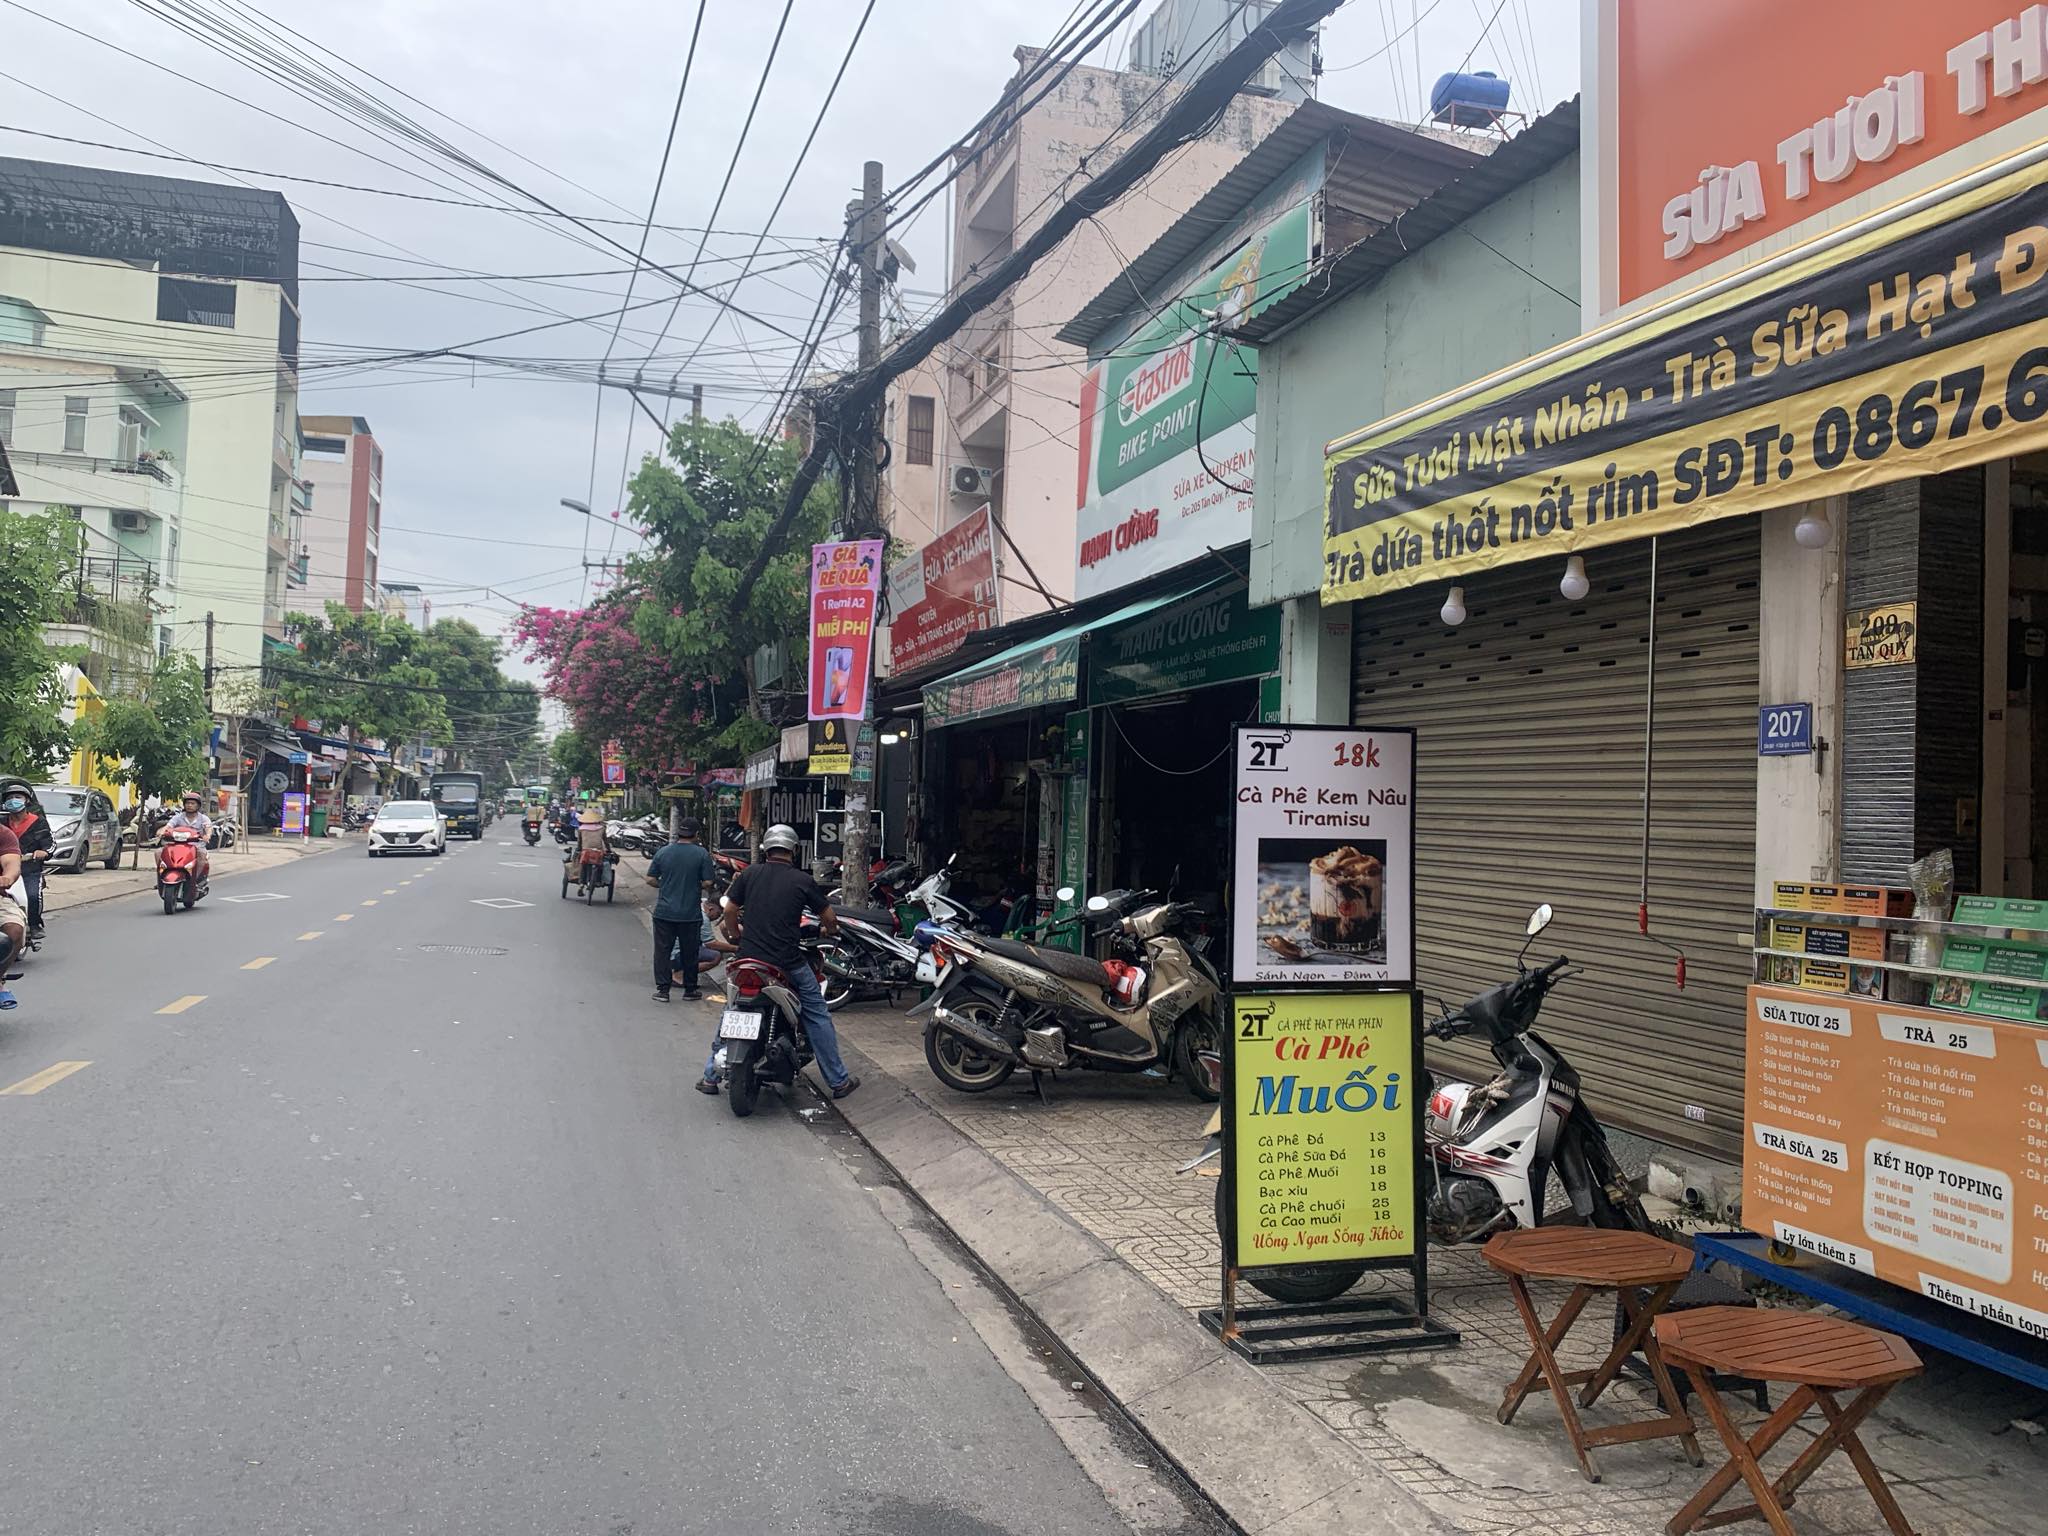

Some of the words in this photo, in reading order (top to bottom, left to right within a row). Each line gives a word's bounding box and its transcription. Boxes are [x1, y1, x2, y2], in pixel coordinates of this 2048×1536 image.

[1663, 161, 1766, 260] SỮA
[1777, 71, 1925, 200] TƯƠI
[1947, 4, 2048, 115] TH
[1135, 341, 1192, 412] Castrol
[1353, 464, 1397, 509] Sữa
[1404, 432, 1461, 492] Tươi
[1468, 416, 1526, 473] Mật
[1533, 382, 1629, 449] Nhãn
[1665, 335, 1737, 404] Trà
[1750, 304, 1849, 378] Sữa
[1867, 251, 1977, 340] Hạt
[1118, 430, 1147, 467] BIKE
[1152, 400, 1196, 447] POINT
[1193, 472, 1204, 492] XE
[1207, 452, 1246, 485] CHUYÊN
[1191, 500, 1200, 514] 205
[1327, 540, 1365, 588] Trà
[1372, 526, 1423, 577] dứa
[1432, 496, 1501, 562] thốt
[1510, 476, 1574, 544] nốt
[1586, 462, 1659, 526] rim
[1673, 423, 1795, 505] SĐT:
[1079, 529, 1112, 569] MẠNH
[1115, 508, 1160, 552] CƯỜNG
[833, 543, 858, 563] GIÁ
[943, 545, 958, 576] XE
[840, 564, 869, 585] QUÁ
[852, 598, 866, 608] A2
[842, 617, 870, 636] PHÍ
[966, 610, 975, 625] XE
[1768, 710, 1803, 738] 207
[1250, 741, 1285, 767] 2T
[1334, 738, 1380, 768] 18k
[1237, 785, 1262, 804] Cà
[1271, 786, 1307, 804] Phê
[1317, 788, 1358, 805] Kem
[1367, 788, 1408, 806] Nâu
[1283, 809, 1370, 827] Tiramisu
[1256, 971, 1287, 980] Sánh
[1241, 1014, 1270, 1037] 2T
[1277, 1017, 1290, 1031] CÀ
[1293, 1017, 1312, 1031] PHÊ
[1314, 1018, 1332, 1032] HẠT
[1335, 1018, 1355, 1030] PHA
[1358, 1017, 1383, 1030] PHIN
[1824, 1017, 1840, 1030] 25
[1904, 1026, 1935, 1043] TRÀ
[1949, 1033, 1967, 1048] 25
[1275, 1036, 1312, 1061] Cà
[1317, 1035, 1370, 1060] Phê
[1793, 1066, 1814, 1077] khoai
[1830, 1060, 1840, 1069] 2T
[1249, 1064, 1403, 1116] Muối
[1551, 1079, 1577, 1099] YAMAHA
[1793, 1080, 1821, 1093] matcha
[1797, 1094, 1807, 1104] 2T
[1793, 1109, 1814, 1120] cacao
[1828, 1118, 1841, 1129] xay
[1258, 1136, 1273, 1147] Cà
[1277, 1134, 1299, 1146] Phê
[1307, 1133, 1324, 1145] Đá
[1369, 1132, 1386, 1142] 13
[1763, 1133, 1786, 1150] TRÀ
[1822, 1149, 1838, 1164] 25
[1258, 1152, 1273, 1164] Cà
[1277, 1151, 1299, 1163] Phê
[1303, 1151, 1326, 1162] Sữa
[1330, 1149, 1346, 1160] Đá
[1369, 1148, 1386, 1159] 16
[1259, 1169, 1275, 1181] Cà
[1279, 1168, 1303, 1180] Phê
[1307, 1166, 1339, 1178] Muối
[1370, 1165, 1386, 1175] 18
[1873, 1151, 1901, 1171] KẾT
[1938, 1170, 2003, 1200] TOPPING
[1259, 1186, 1283, 1199] Bạc
[1370, 1181, 1387, 1192] 18
[1259, 1204, 1276, 1215] Cà
[1281, 1201, 1305, 1213] Phê
[1309, 1199, 1345, 1212] chuối
[1372, 1198, 1390, 1208] 25
[1261, 1217, 1277, 1228] Ca
[1281, 1216, 1306, 1226] Cao
[1310, 1213, 1342, 1225] muối
[1374, 1210, 1390, 1221] 18
[1253, 1231, 1289, 1252] Uống
[1294, 1230, 1329, 1250] Ngon
[1333, 1226, 1366, 1248] Sống
[1783, 1229, 1795, 1245] Ly
[1849, 1252, 1856, 1265] 5
[1969, 1297, 1975, 1311] 1
